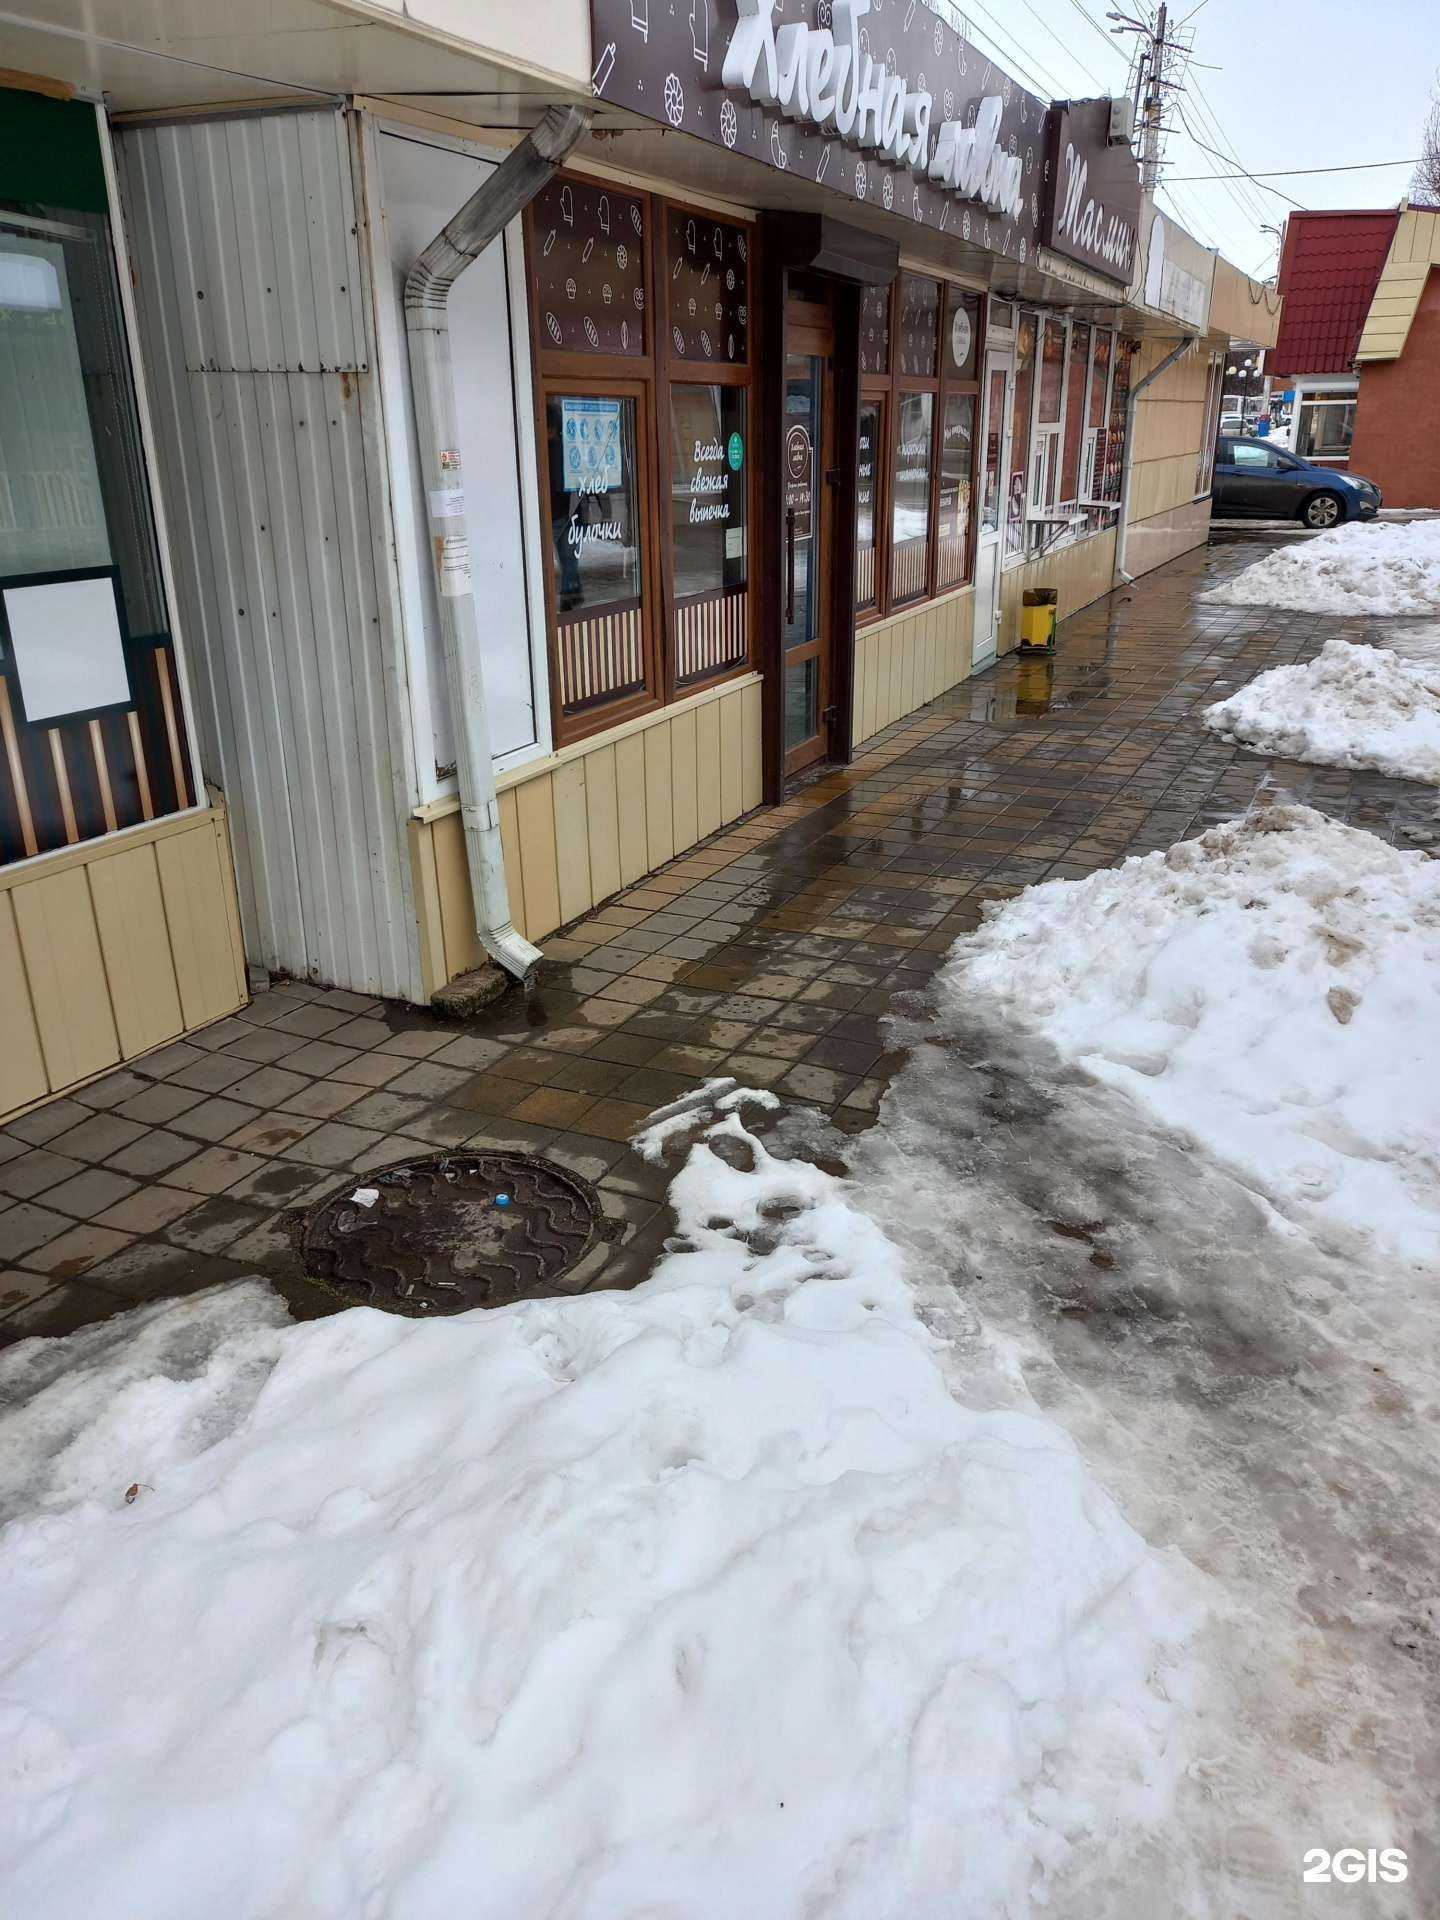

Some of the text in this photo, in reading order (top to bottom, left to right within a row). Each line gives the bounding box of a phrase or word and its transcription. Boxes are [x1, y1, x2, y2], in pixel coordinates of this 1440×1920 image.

[722, 0, 932, 170] Хлебная
[694, 437, 725, 462] Всегда
[578, 464, 610, 497] хлеб
[690, 467, 729, 493] свежая
[689, 497, 731, 523] выпечка
[568, 513, 621, 559] булочки
